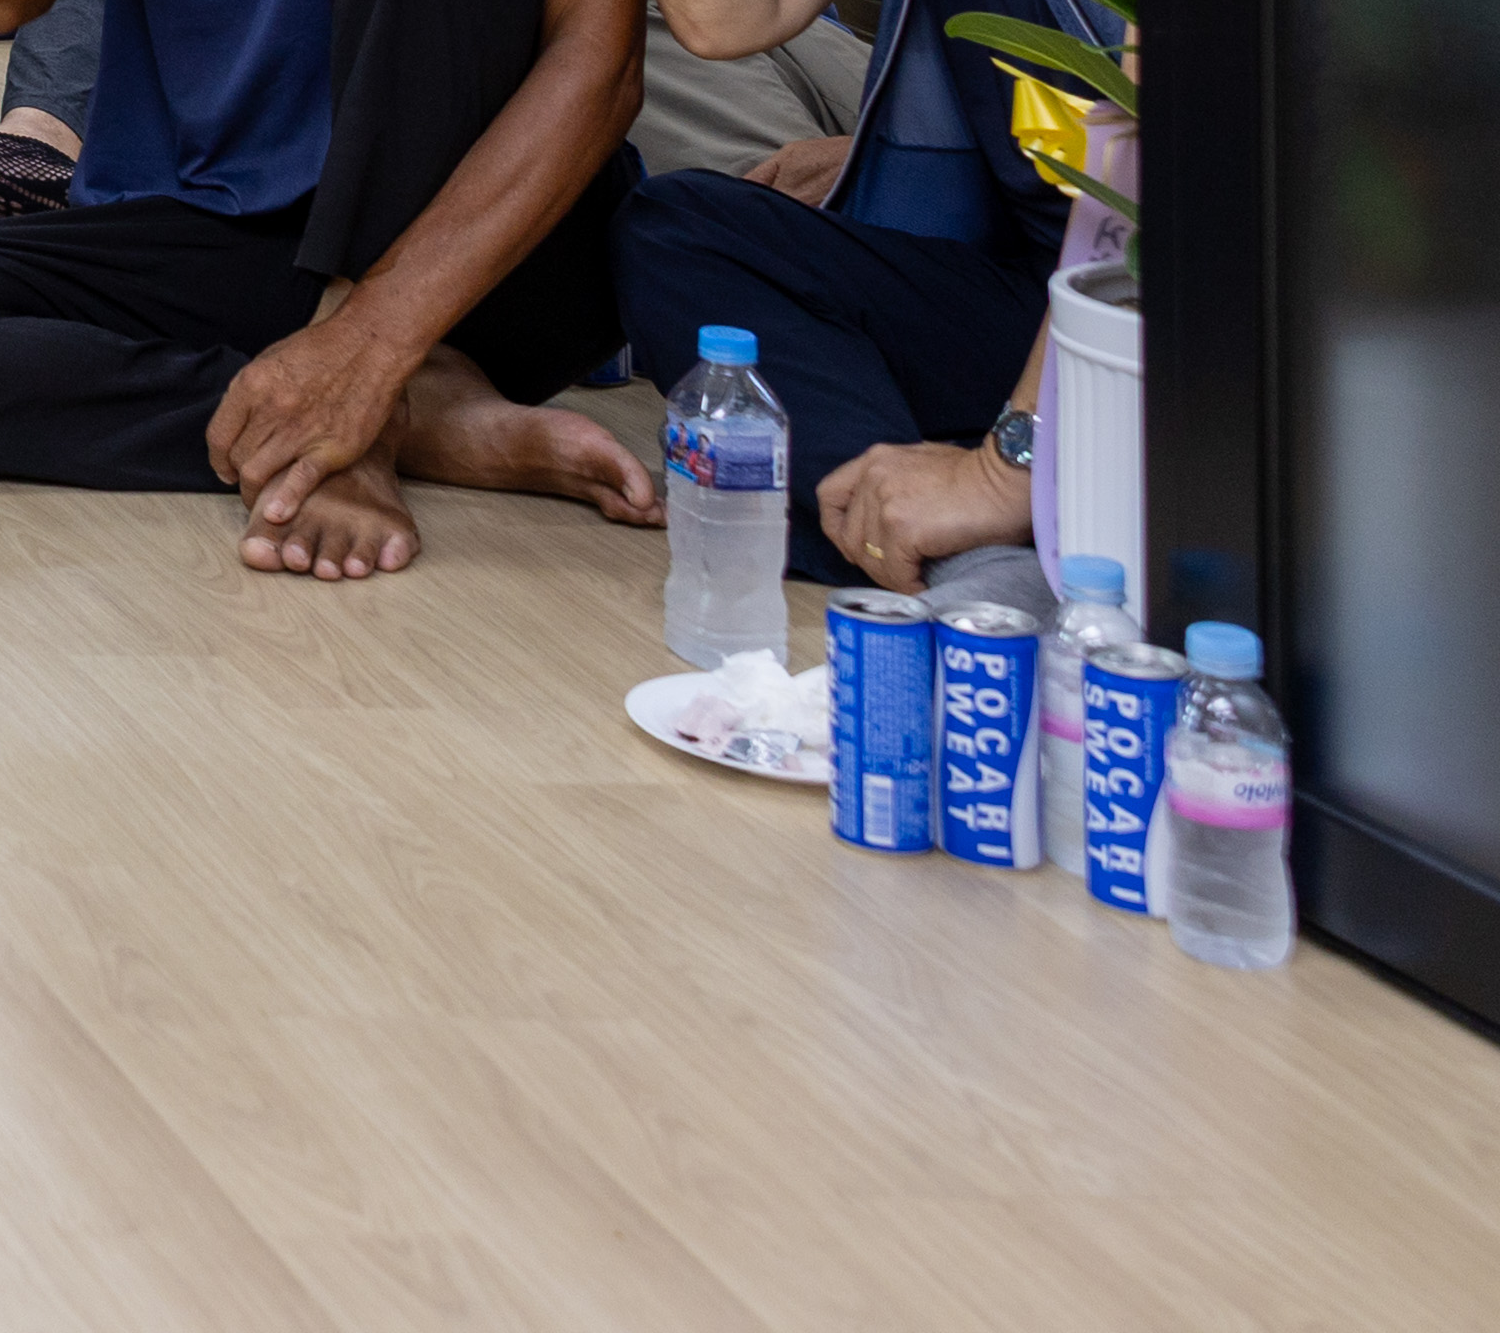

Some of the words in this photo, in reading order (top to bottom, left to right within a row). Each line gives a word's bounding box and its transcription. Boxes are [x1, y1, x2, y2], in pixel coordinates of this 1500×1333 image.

[943, 643, 979, 832] SWEAT
[974, 651, 1012, 860] POCARI
[1083, 679, 1112, 873] SWEAT
[1105, 688, 1145, 905] POCARI
